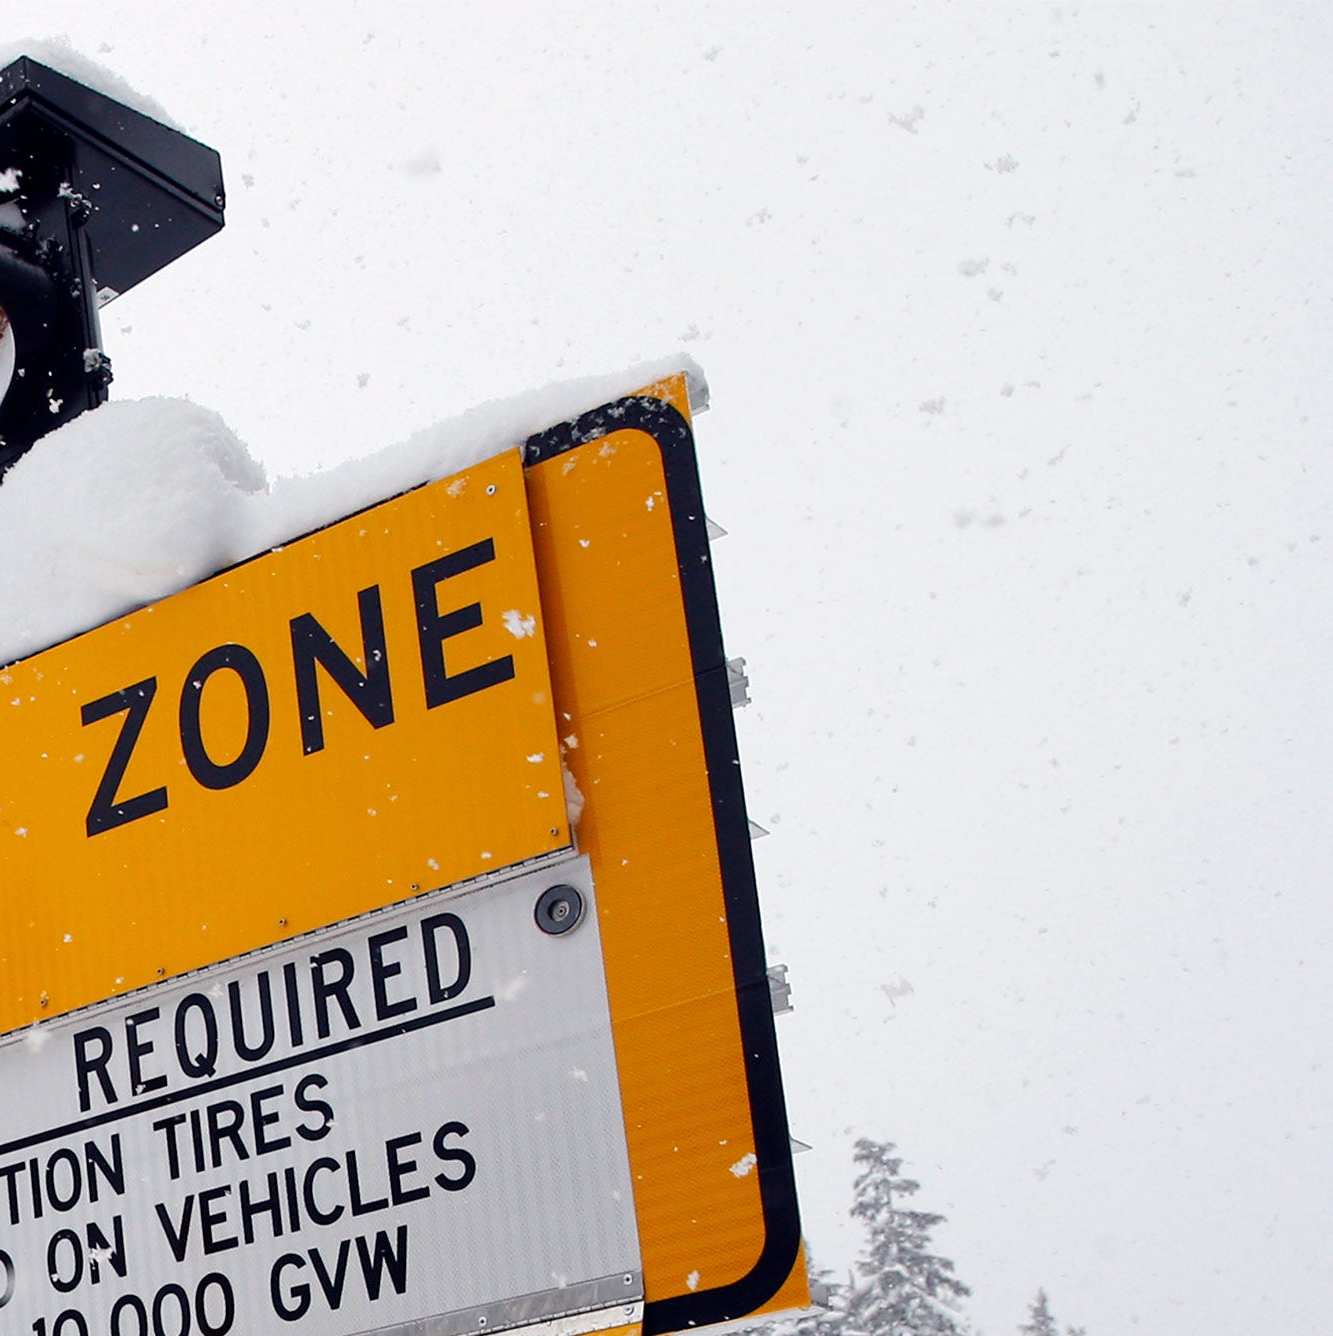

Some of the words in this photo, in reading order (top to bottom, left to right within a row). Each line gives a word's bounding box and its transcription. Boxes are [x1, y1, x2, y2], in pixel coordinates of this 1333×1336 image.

[80, 536, 517, 838] ZONE
[72, 911, 473, 1114] REQUIRED
[46, 1213, 128, 1294] ON
[153, 1120, 477, 1264] VEHICLES
[151, 1073, 335, 1181] TIRES
[269, 1223, 409, 1323] GVW
